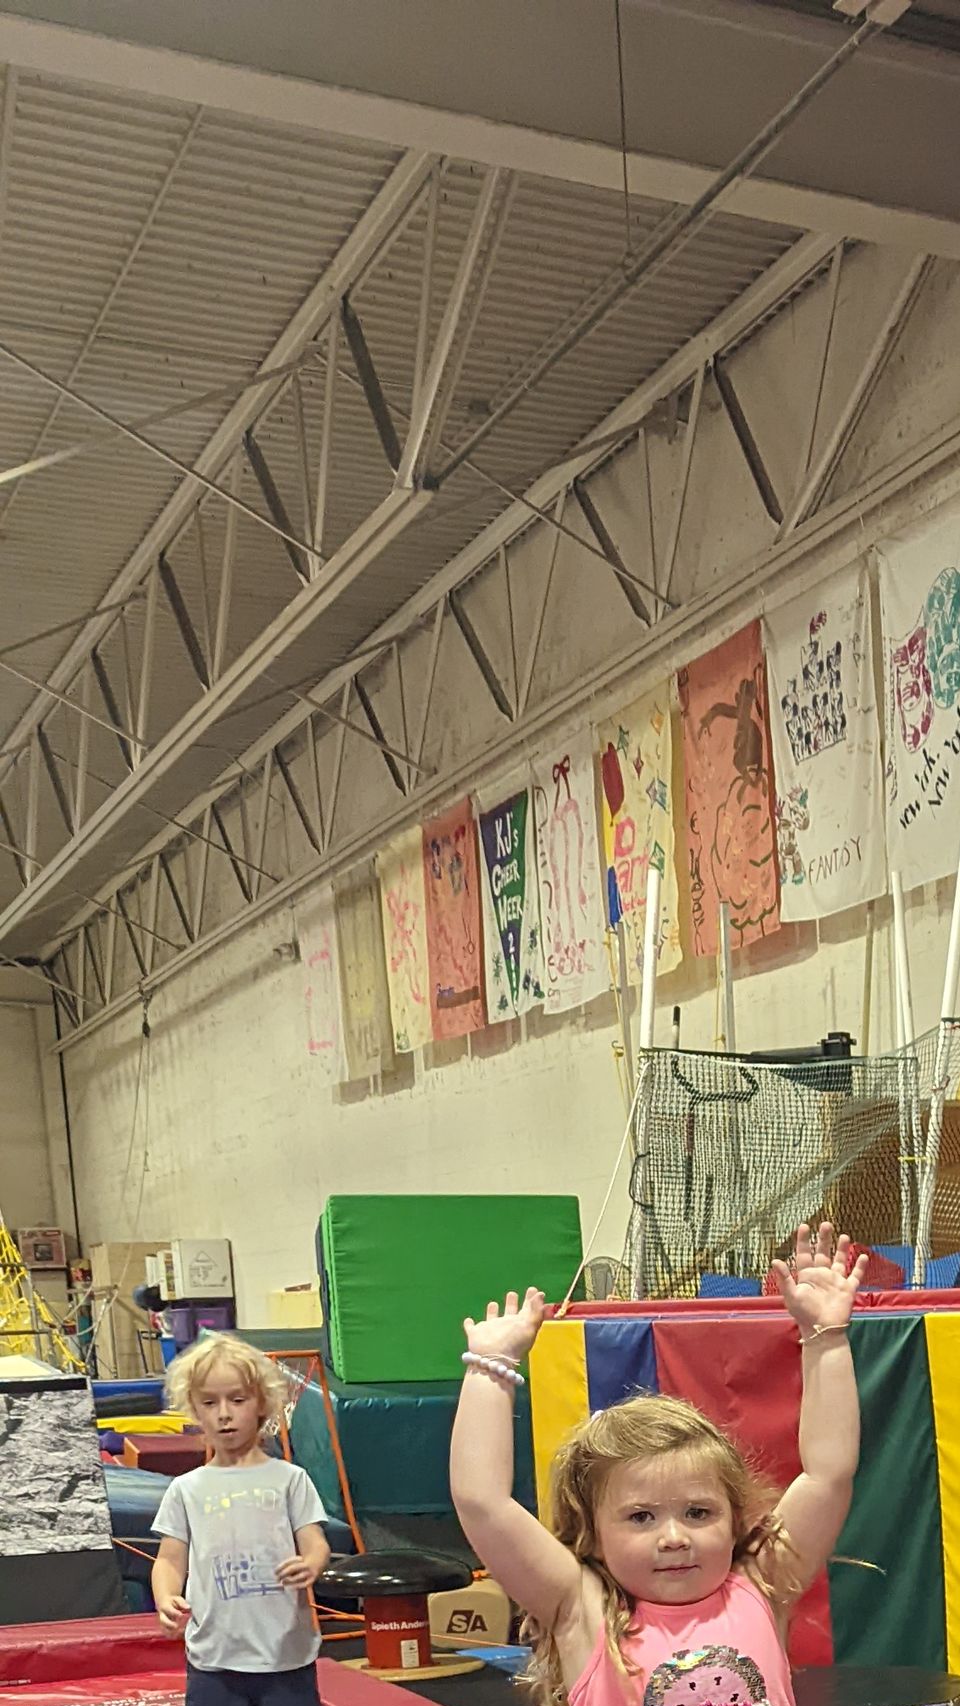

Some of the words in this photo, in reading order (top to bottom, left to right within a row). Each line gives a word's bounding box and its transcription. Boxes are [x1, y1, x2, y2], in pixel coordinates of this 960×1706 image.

[492, 858, 521, 896] CHEER
[498, 896, 524, 932] WEEK
[371, 1621, 400, 1632] Spieth
[446, 1609, 488, 1634] SA
